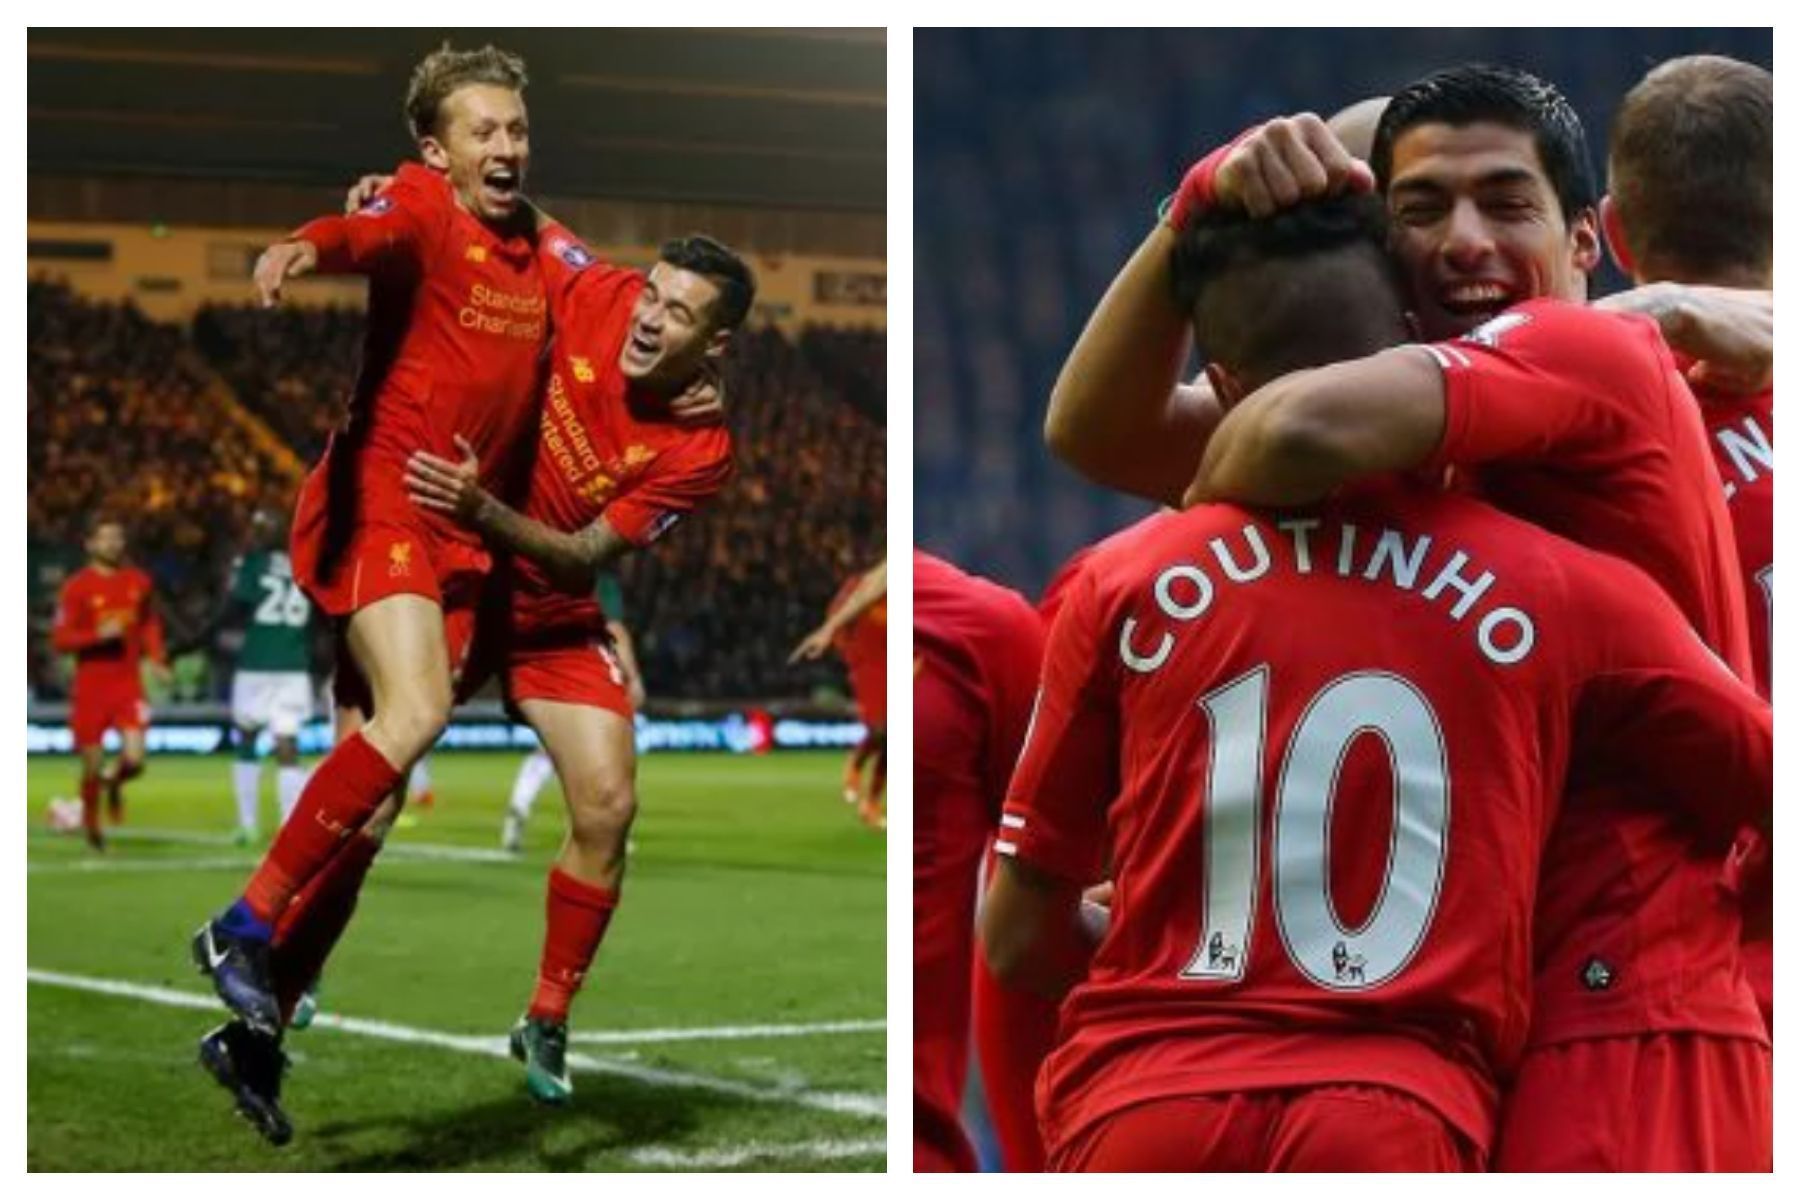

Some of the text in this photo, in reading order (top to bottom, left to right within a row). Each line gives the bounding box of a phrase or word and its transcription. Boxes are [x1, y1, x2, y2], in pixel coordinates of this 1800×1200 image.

[548, 373, 600, 471] Standard
[254, 574, 310, 627] 26
[1119, 519, 1536, 674] COUTINHO
[1179, 663, 1451, 992] 10
